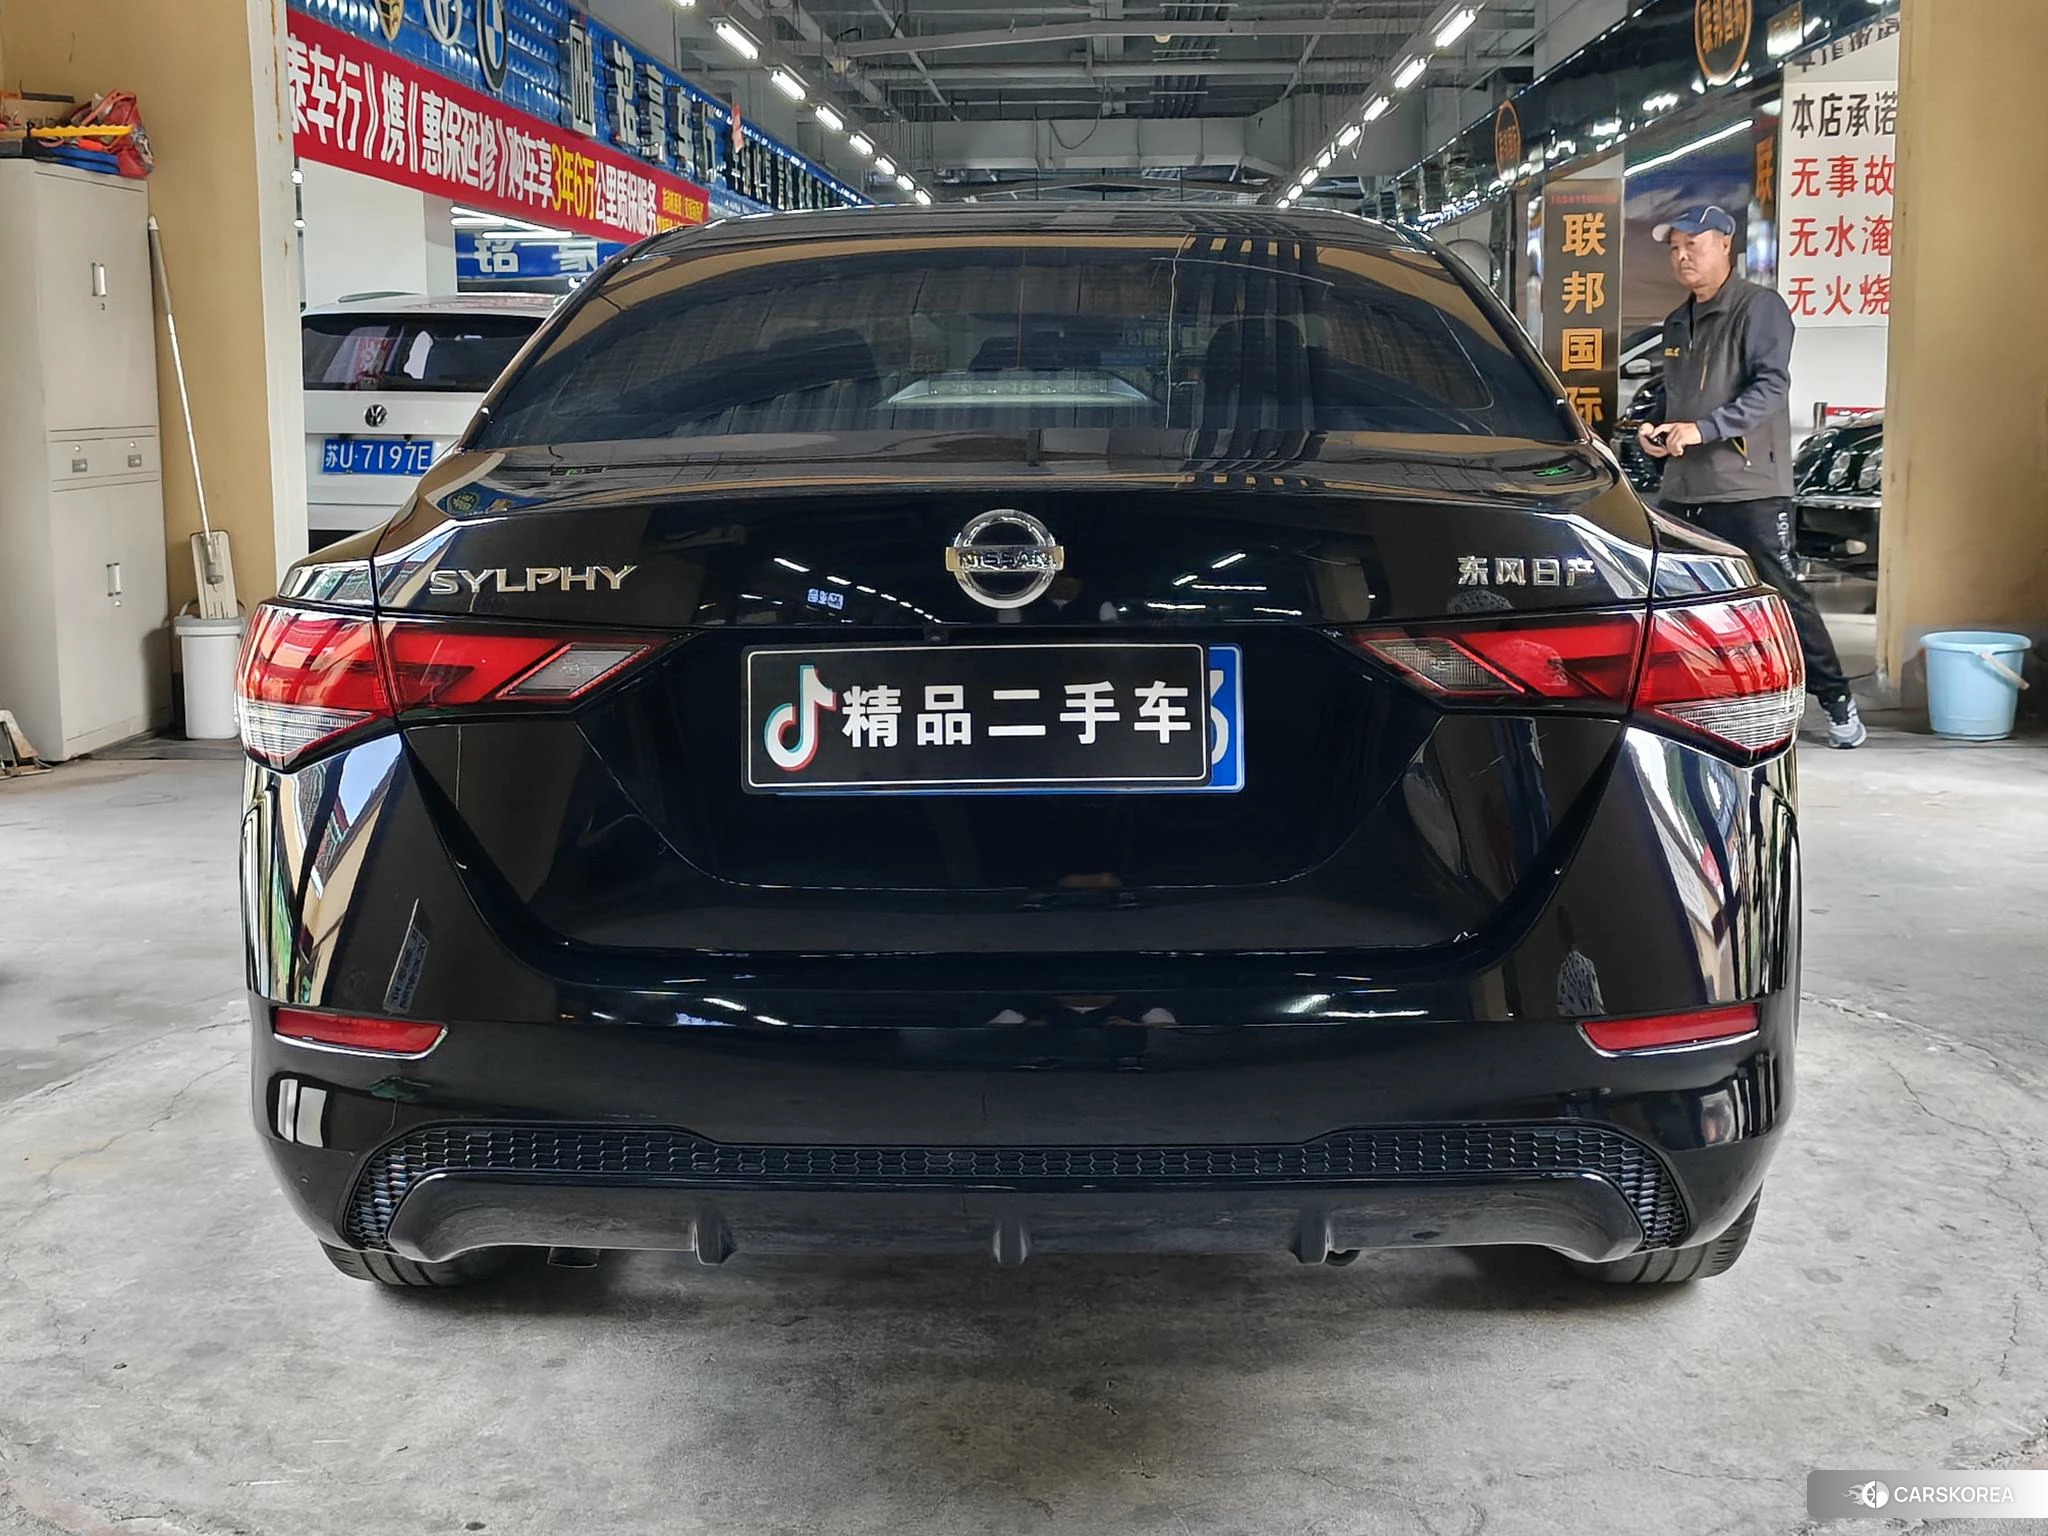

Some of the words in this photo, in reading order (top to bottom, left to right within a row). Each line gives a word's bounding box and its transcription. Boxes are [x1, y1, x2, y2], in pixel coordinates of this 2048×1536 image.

[1791, 91, 1897, 139] 本店承诺
[1791, 154, 1895, 198] 无事故
[1788, 214, 1892, 258] 无水淹
[1788, 275, 1890, 316] 无火烧
[429, 565, 638, 595] SYLPHY
[960, 550, 1056, 570] NISSAN
[1456, 555, 1596, 587] 东风日产
[842, 680, 1192, 748] 精品二手车
